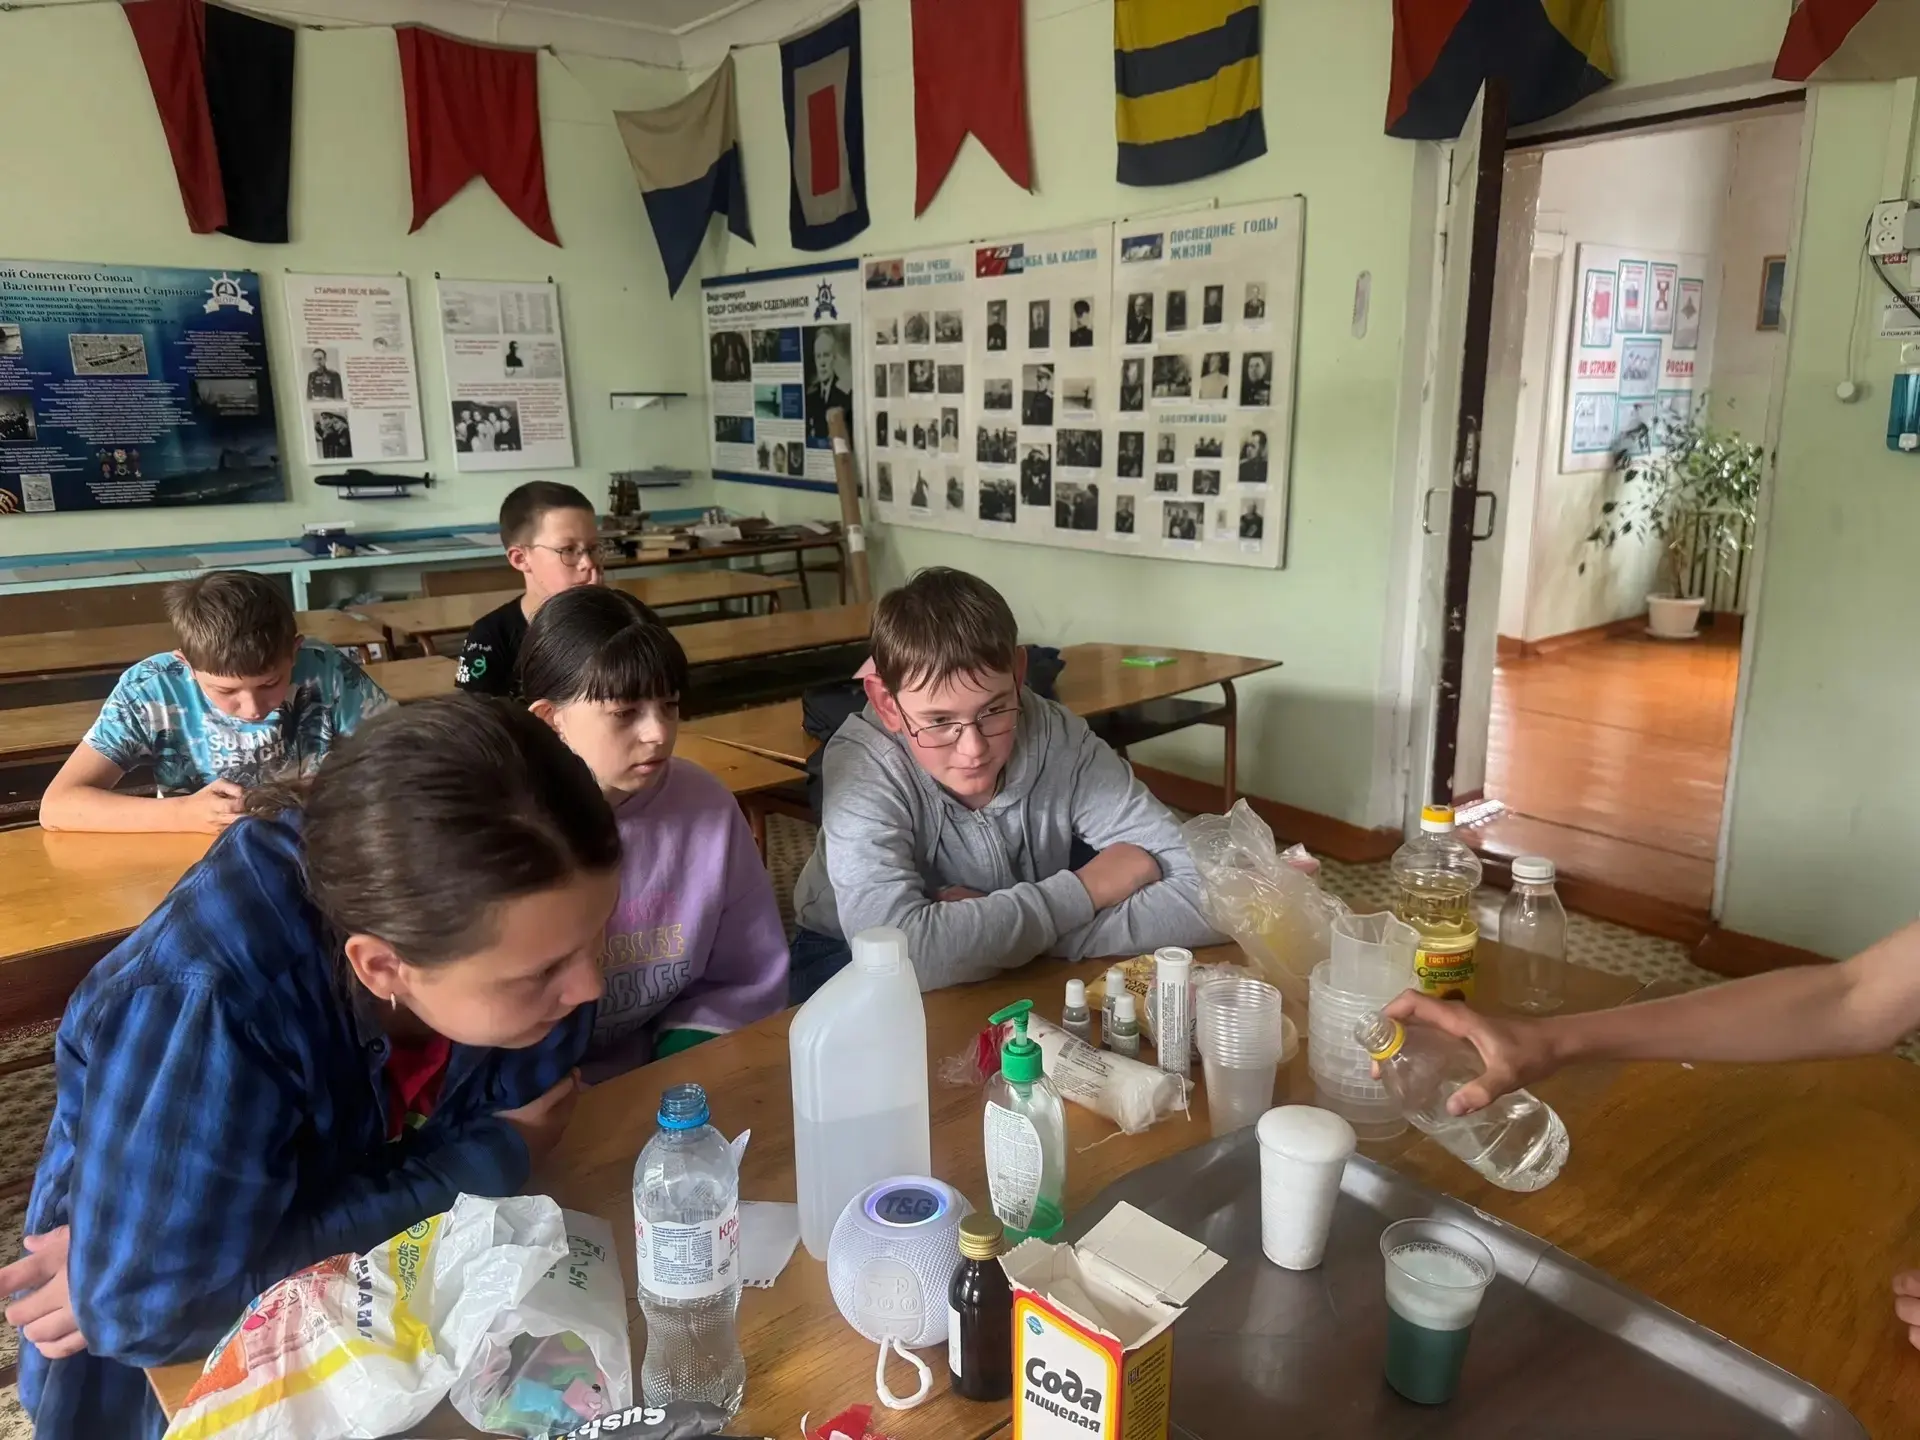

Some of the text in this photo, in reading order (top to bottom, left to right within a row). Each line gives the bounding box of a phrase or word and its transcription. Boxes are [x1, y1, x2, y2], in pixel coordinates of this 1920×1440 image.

[1170, 216, 1279, 244] ПОСЛЕДНИЕ ГОДЫ
[1046, 252, 1059, 266] НА
[1170, 242, 1212, 260] ЖИЗНИ
[19, 269, 91, 281] Советского
[94, 272, 133, 283] Союза
[3, 281, 200, 298] Валентин Георгиевич Стариков
[208, 724, 283, 751] SUNNY
[211, 741, 285, 769] BEACH
[884, 1196, 933, 1217] T&G
[1025, 1357, 1102, 1413] Сода
[1024, 1388, 1101, 1433] пищевая
